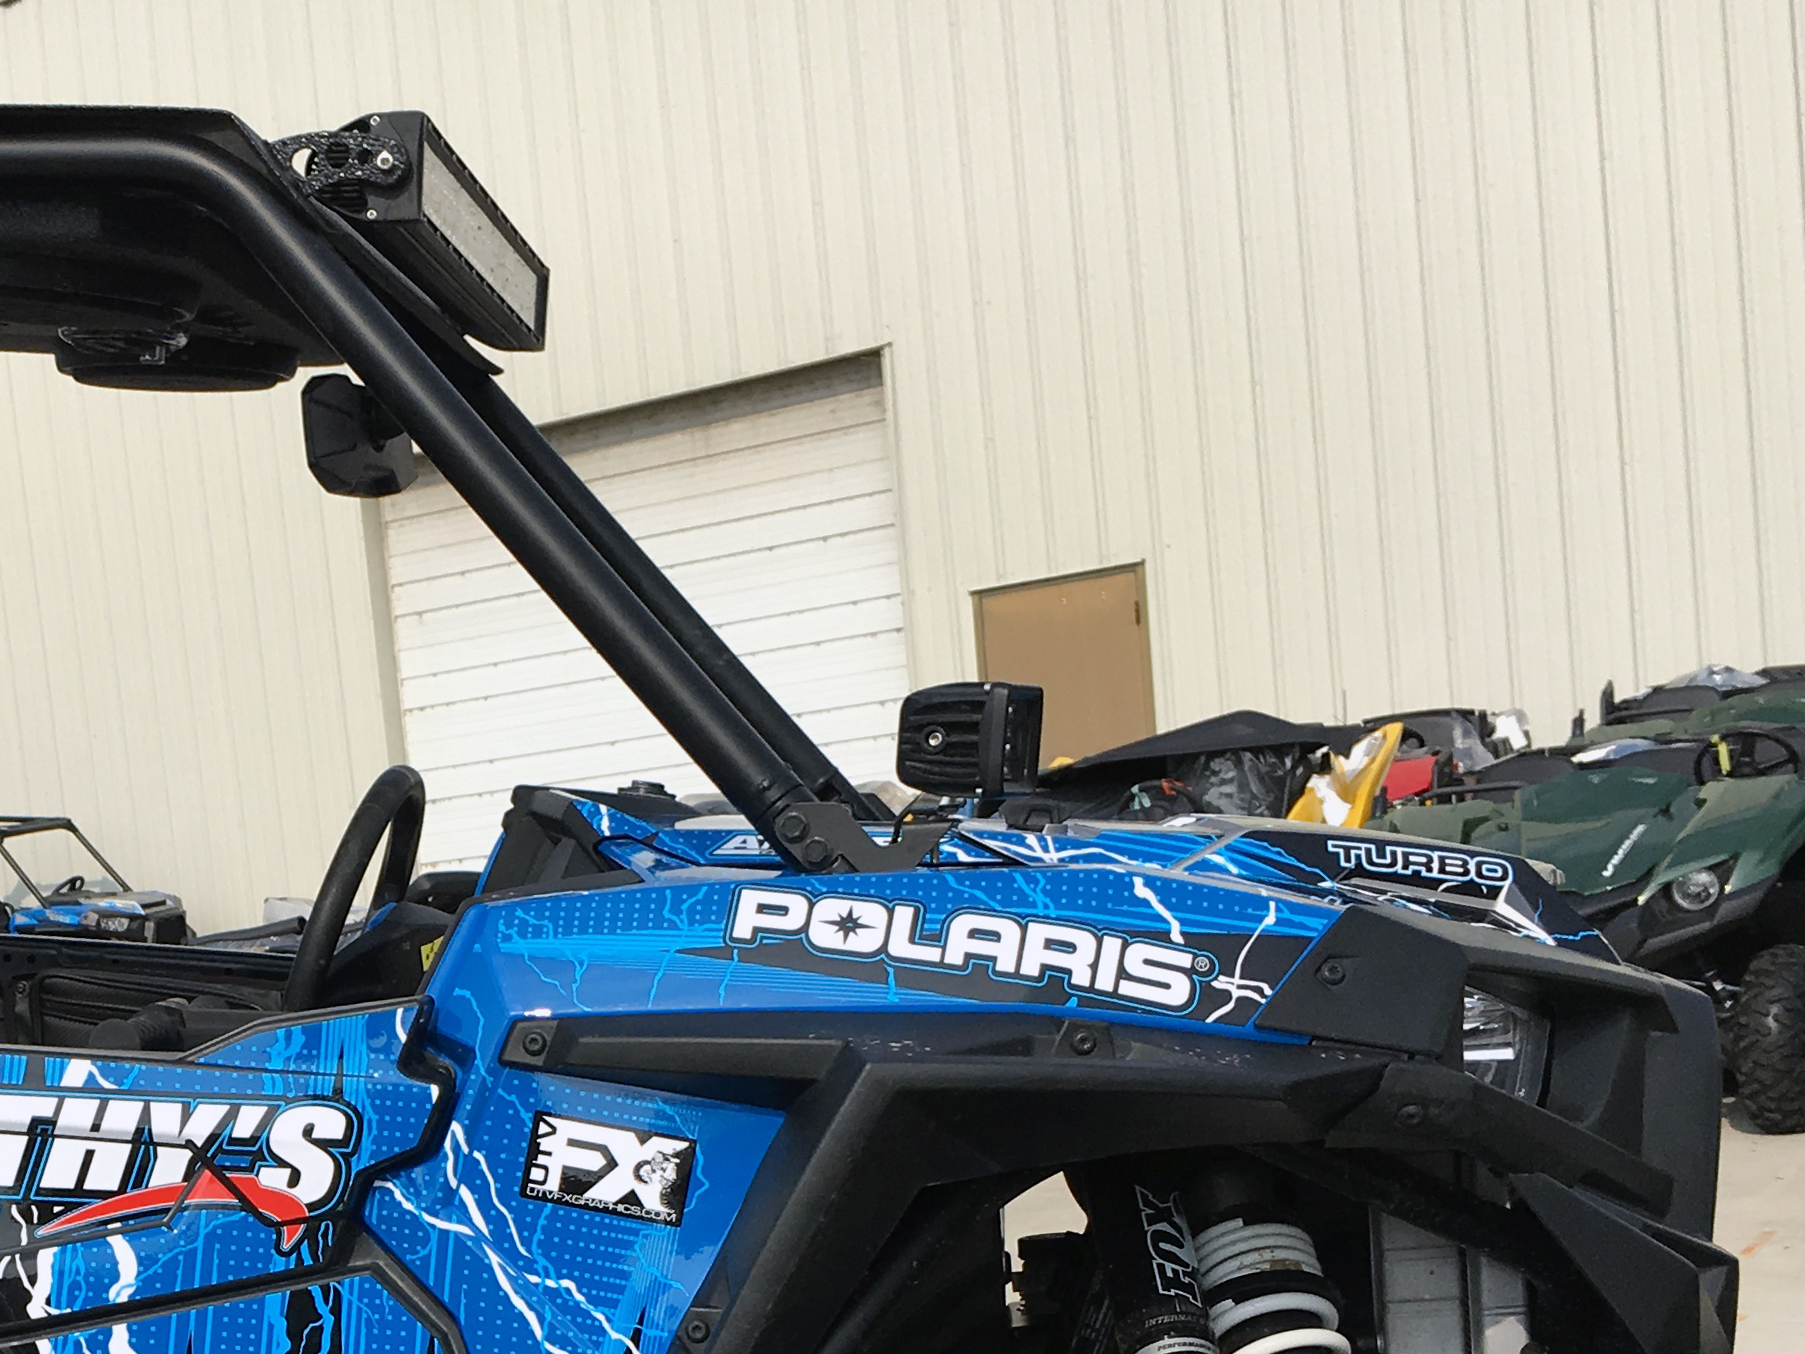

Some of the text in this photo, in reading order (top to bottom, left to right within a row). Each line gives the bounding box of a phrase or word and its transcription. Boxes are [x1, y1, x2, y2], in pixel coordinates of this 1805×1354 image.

[1327, 840, 1513, 883] TURBO
[528, 1116, 558, 1187] UTV
[541, 1116, 690, 1213] FX
[525, 1186, 677, 1223] UTVFXGRAPHICS.COM
[1134, 1184, 1203, 1309] FOX
